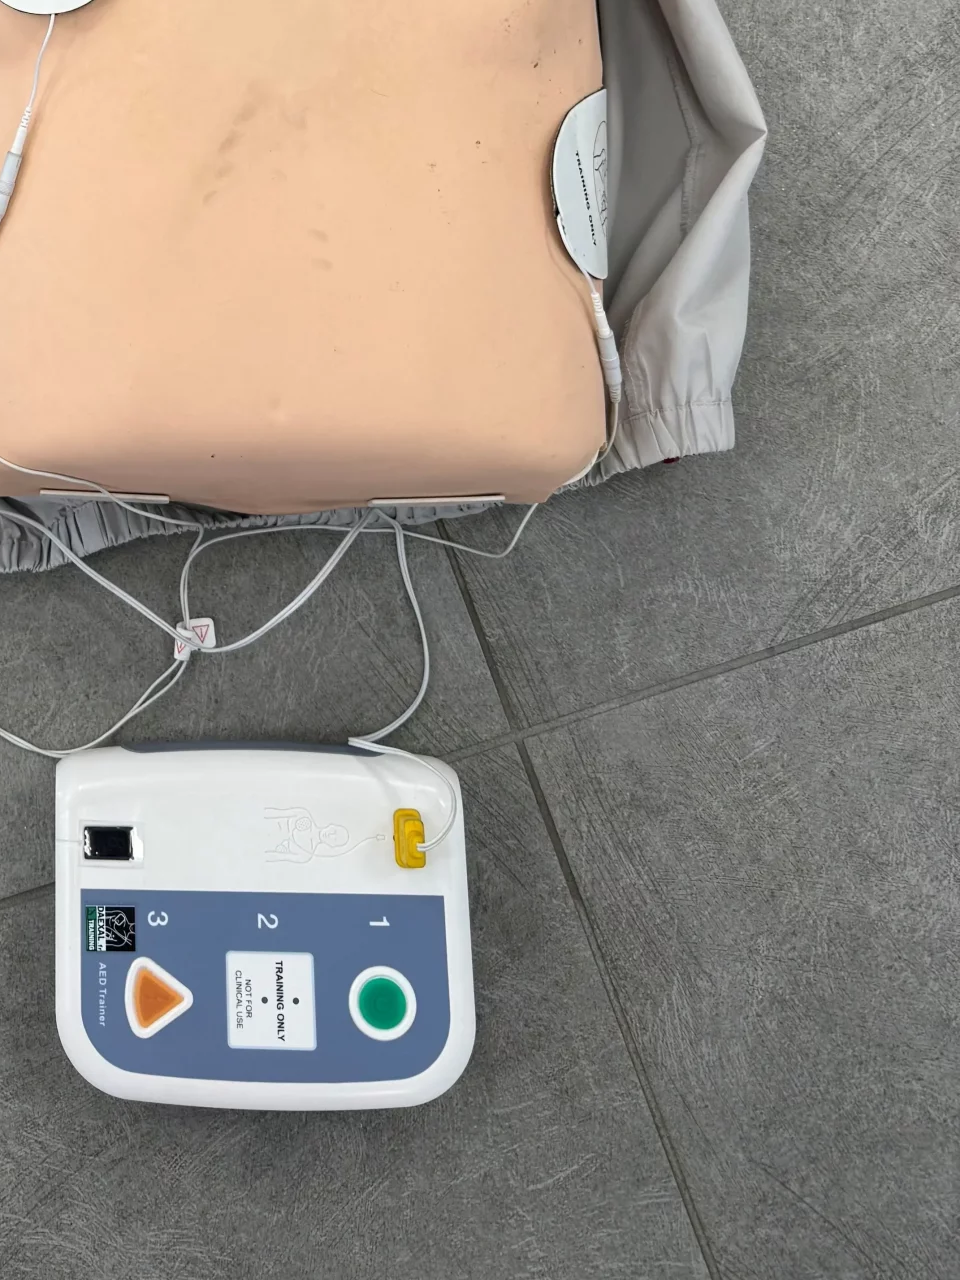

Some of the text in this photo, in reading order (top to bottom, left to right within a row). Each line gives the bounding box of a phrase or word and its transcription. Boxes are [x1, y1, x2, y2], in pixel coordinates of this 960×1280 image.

[576, 150, 597, 246] TRAINING ONLY
[147, 910, 169, 927] 3
[257, 912, 279, 930] 2
[369, 916, 391, 927] 1
[98, 961, 107, 1027] AED Trainer
[235, 970, 244, 1029] CLINICAL USE
[245, 979, 253, 1018] NOT FOR
[275, 960, 286, 1042] TRAINING ONLY
